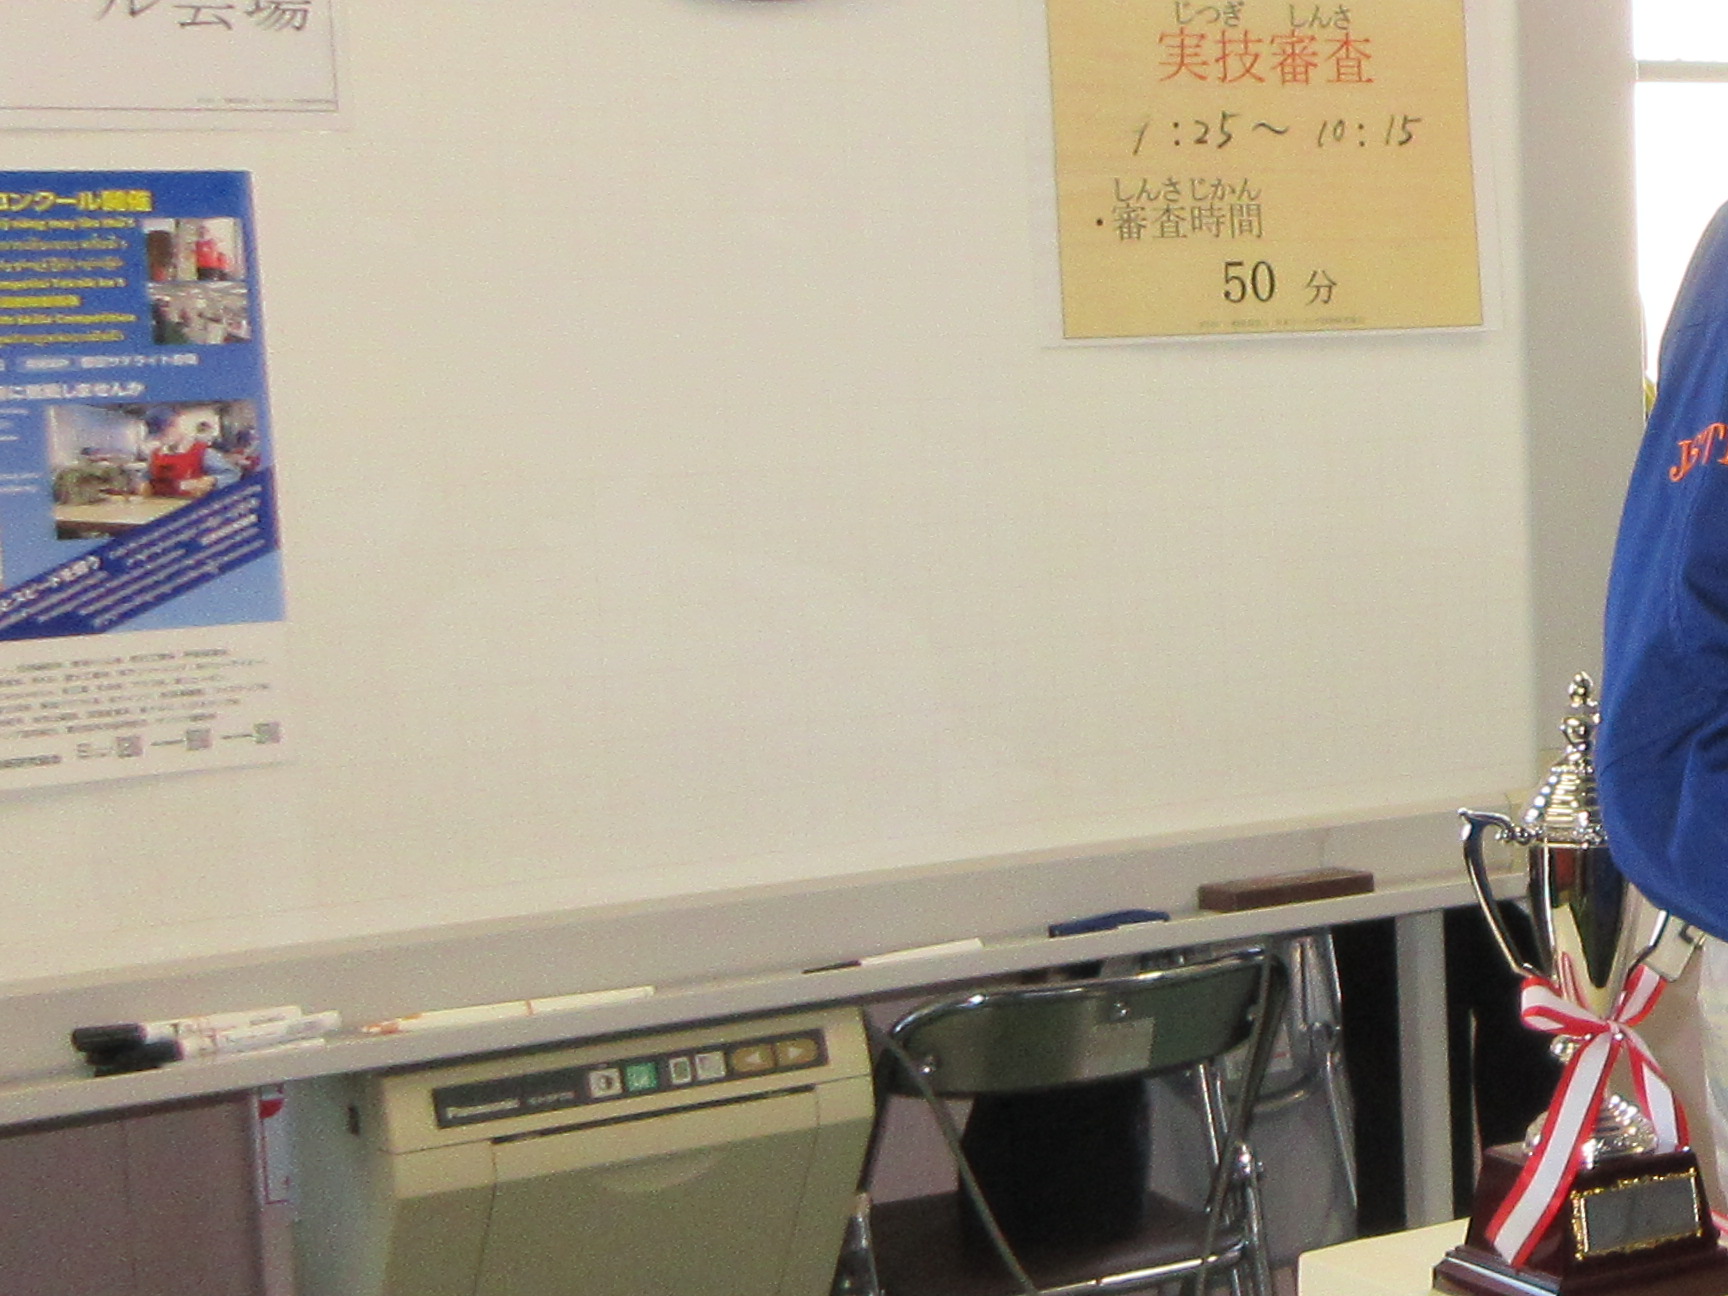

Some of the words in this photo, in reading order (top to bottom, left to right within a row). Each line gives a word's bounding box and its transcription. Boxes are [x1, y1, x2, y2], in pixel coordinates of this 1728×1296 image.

[1174, 0, 1244, 27] じつぎ
[1287, 3, 1353, 31] しんさ
[1157, 26, 1375, 86] 実技審査
[1114, 177, 1261, 203] しんさじかん
[1223, 260, 1276, 304] 50
[1306, 269, 1337, 306] 分
